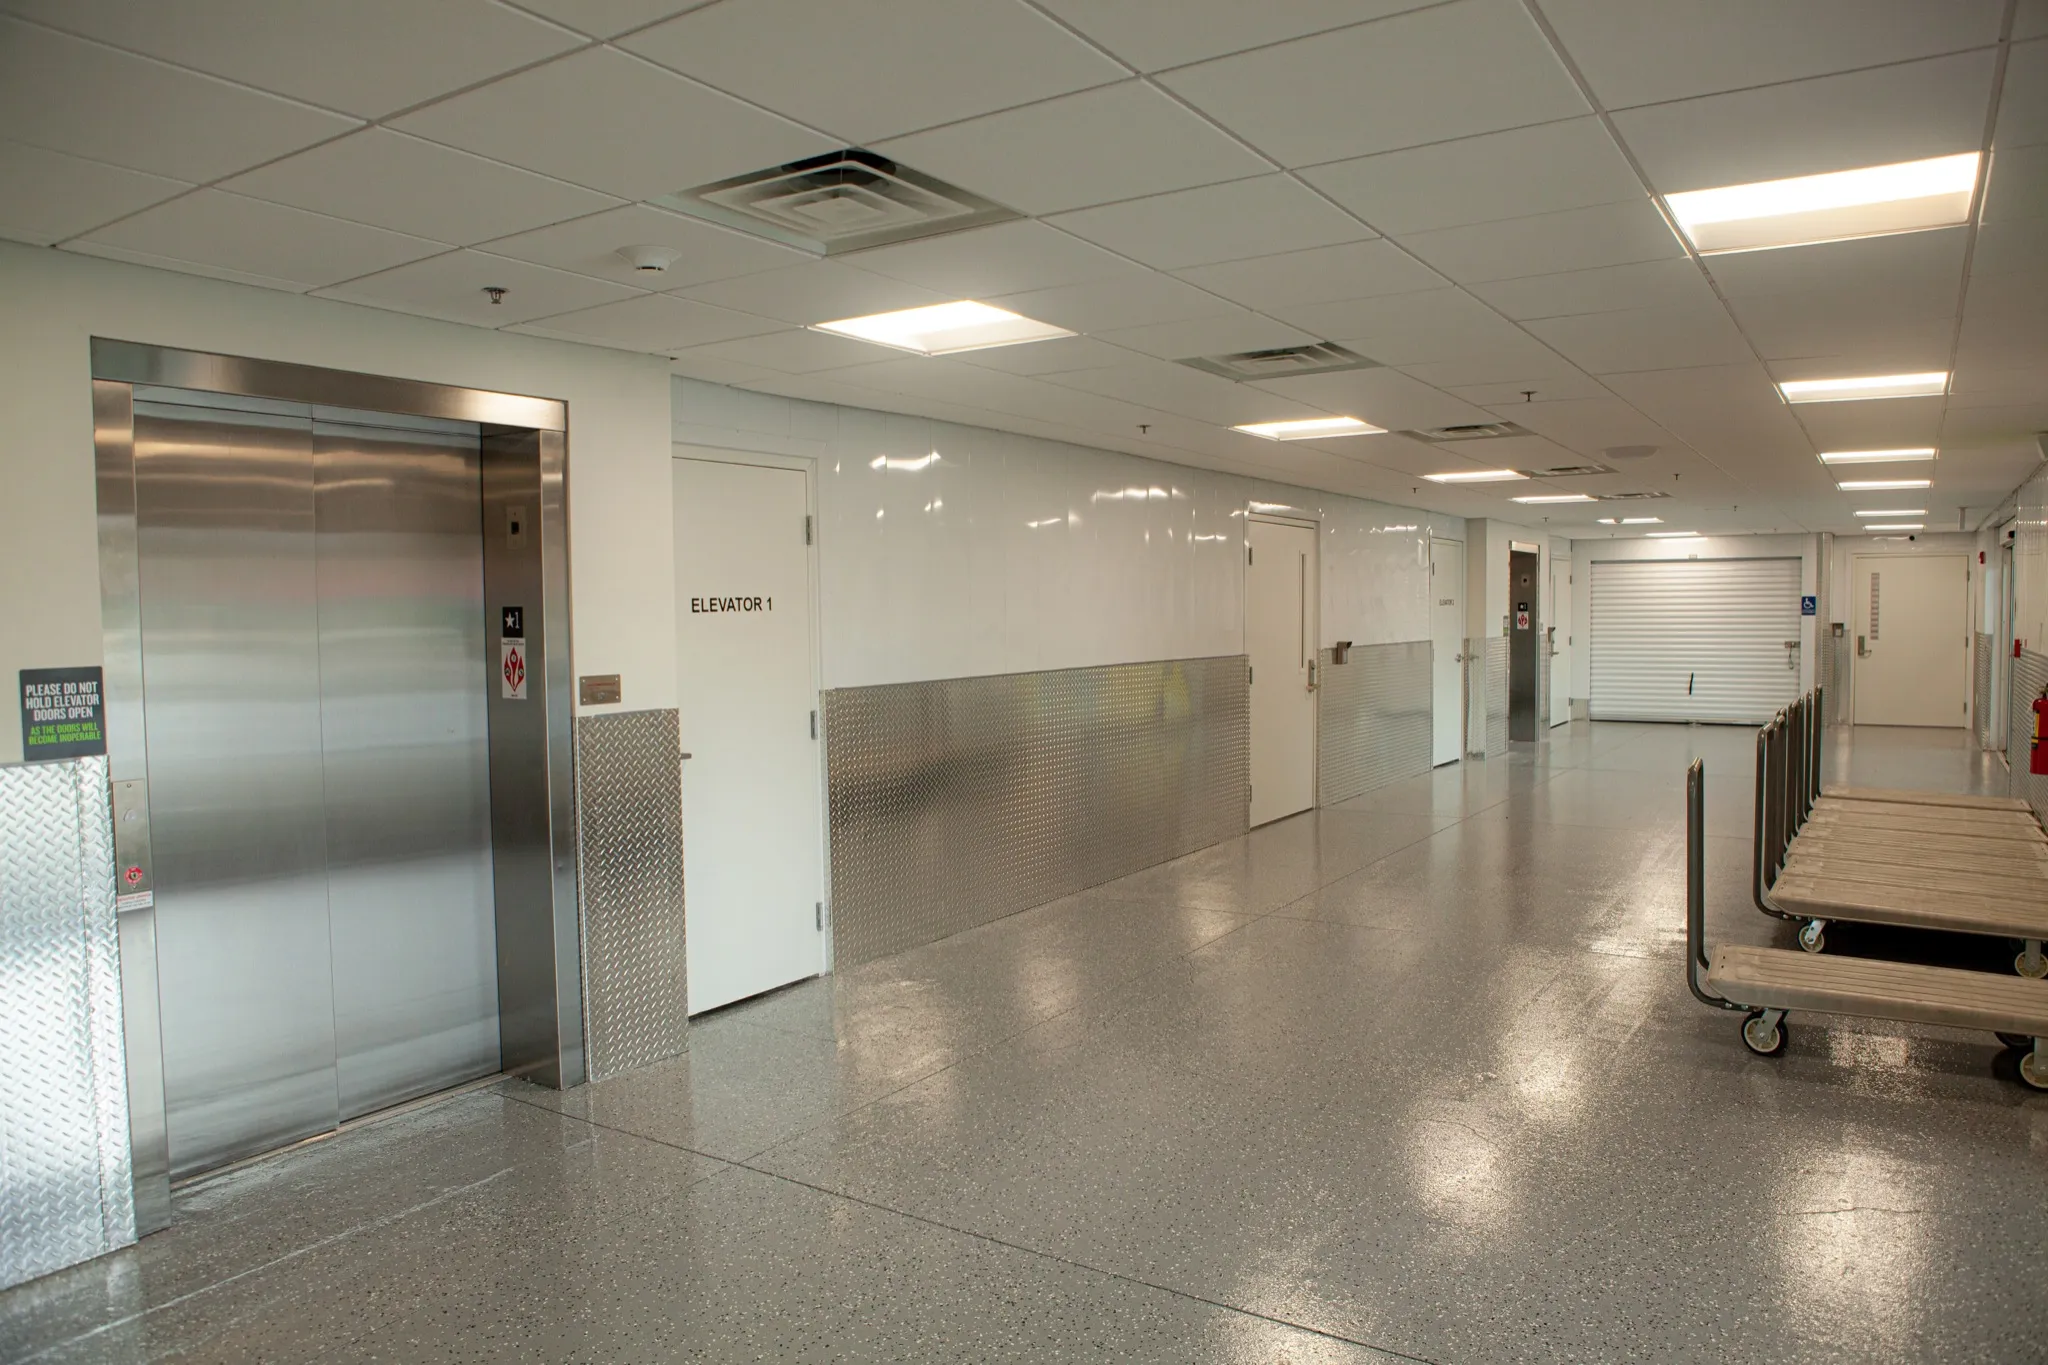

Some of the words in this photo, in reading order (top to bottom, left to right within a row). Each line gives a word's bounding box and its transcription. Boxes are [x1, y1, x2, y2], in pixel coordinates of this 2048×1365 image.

[691, 597, 763, 613] ELEVATOR
[766, 597, 772, 611] 1
[514, 612, 520, 629] 1
[25, 683, 62, 697] PLEASE
[64, 682, 77, 695] DO
[79, 681, 98, 693] NOT
[25, 697, 52, 710] HOLD
[54, 694, 100, 708] ELEVATOR
[34, 708, 67, 721] DOORS
[68, 707, 93, 719] OPEN
[30, 726, 41, 735] AS
[42, 724, 56, 734] THE
[57, 723, 81, 733] DOORS
[82, 722, 98, 732] WILL
[28, 734, 58, 745] BECOME
[59, 731, 101, 743] INOPERABLE
